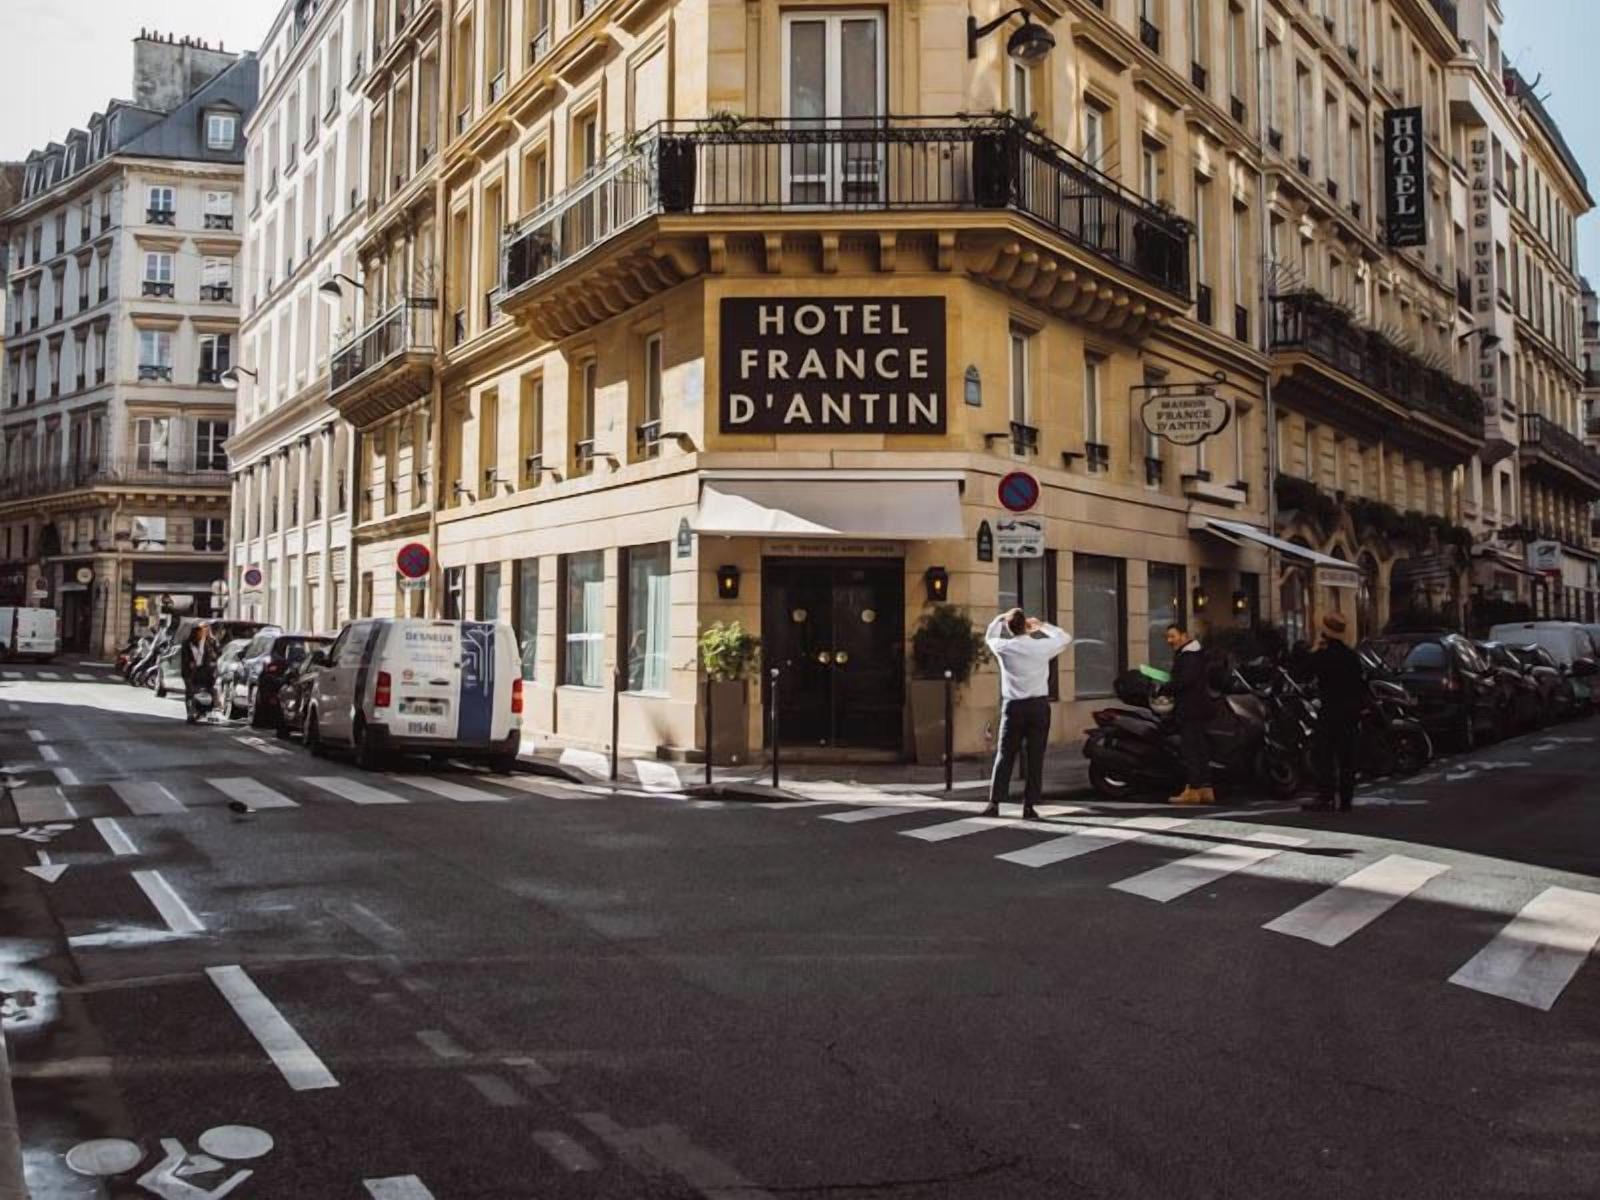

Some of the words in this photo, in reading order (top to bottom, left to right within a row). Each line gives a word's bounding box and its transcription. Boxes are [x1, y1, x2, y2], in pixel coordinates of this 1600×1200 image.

[1392, 116, 1416, 215] HOTEL
[758, 304, 909, 336] HOTEL
[740, 348, 928, 380] FRANCE
[729, 392, 938, 424] D'ANTIN
[1156, 409, 1211, 420] FRANCE
[1157, 421, 1210, 432] D'ANTIN
